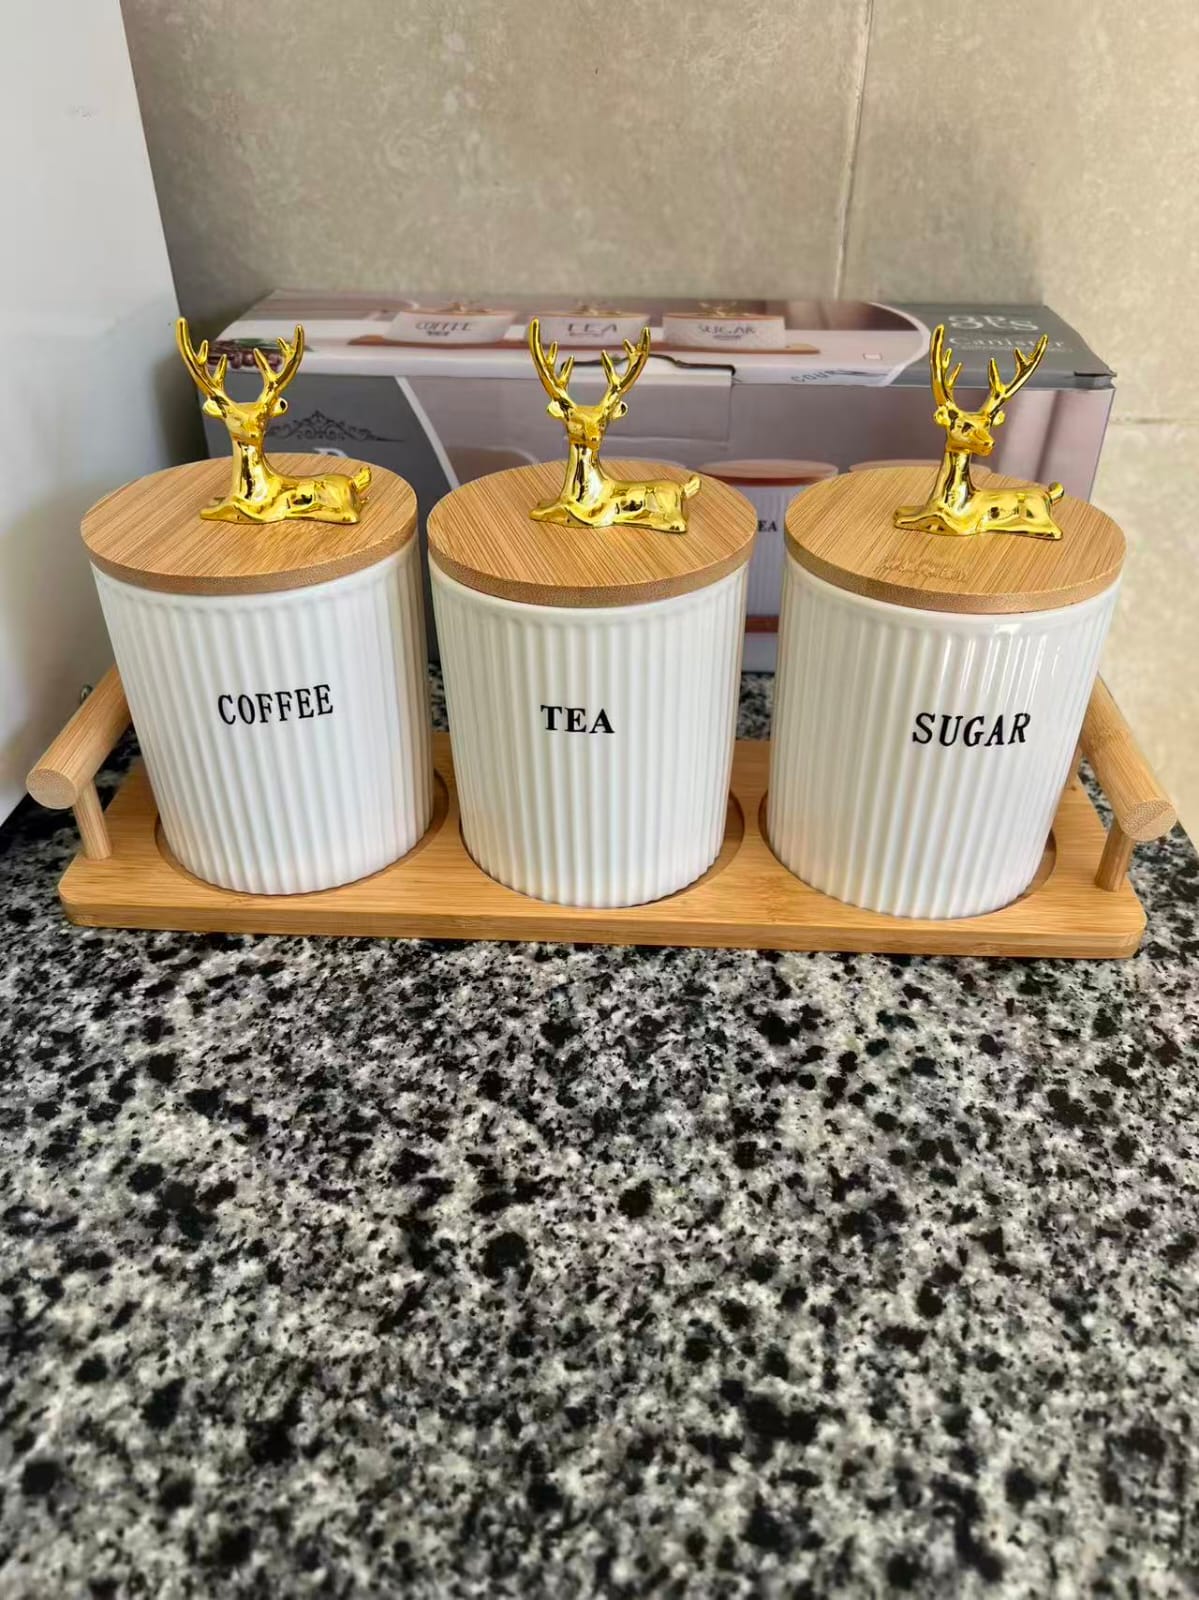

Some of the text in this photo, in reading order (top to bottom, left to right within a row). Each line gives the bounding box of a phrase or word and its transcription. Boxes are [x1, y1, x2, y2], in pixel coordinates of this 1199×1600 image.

[757, 519, 777, 532] EA
[217, 684, 334, 725] COFFEE
[540, 704, 616, 734] TEA
[911, 712, 1031, 747] SUGAR
